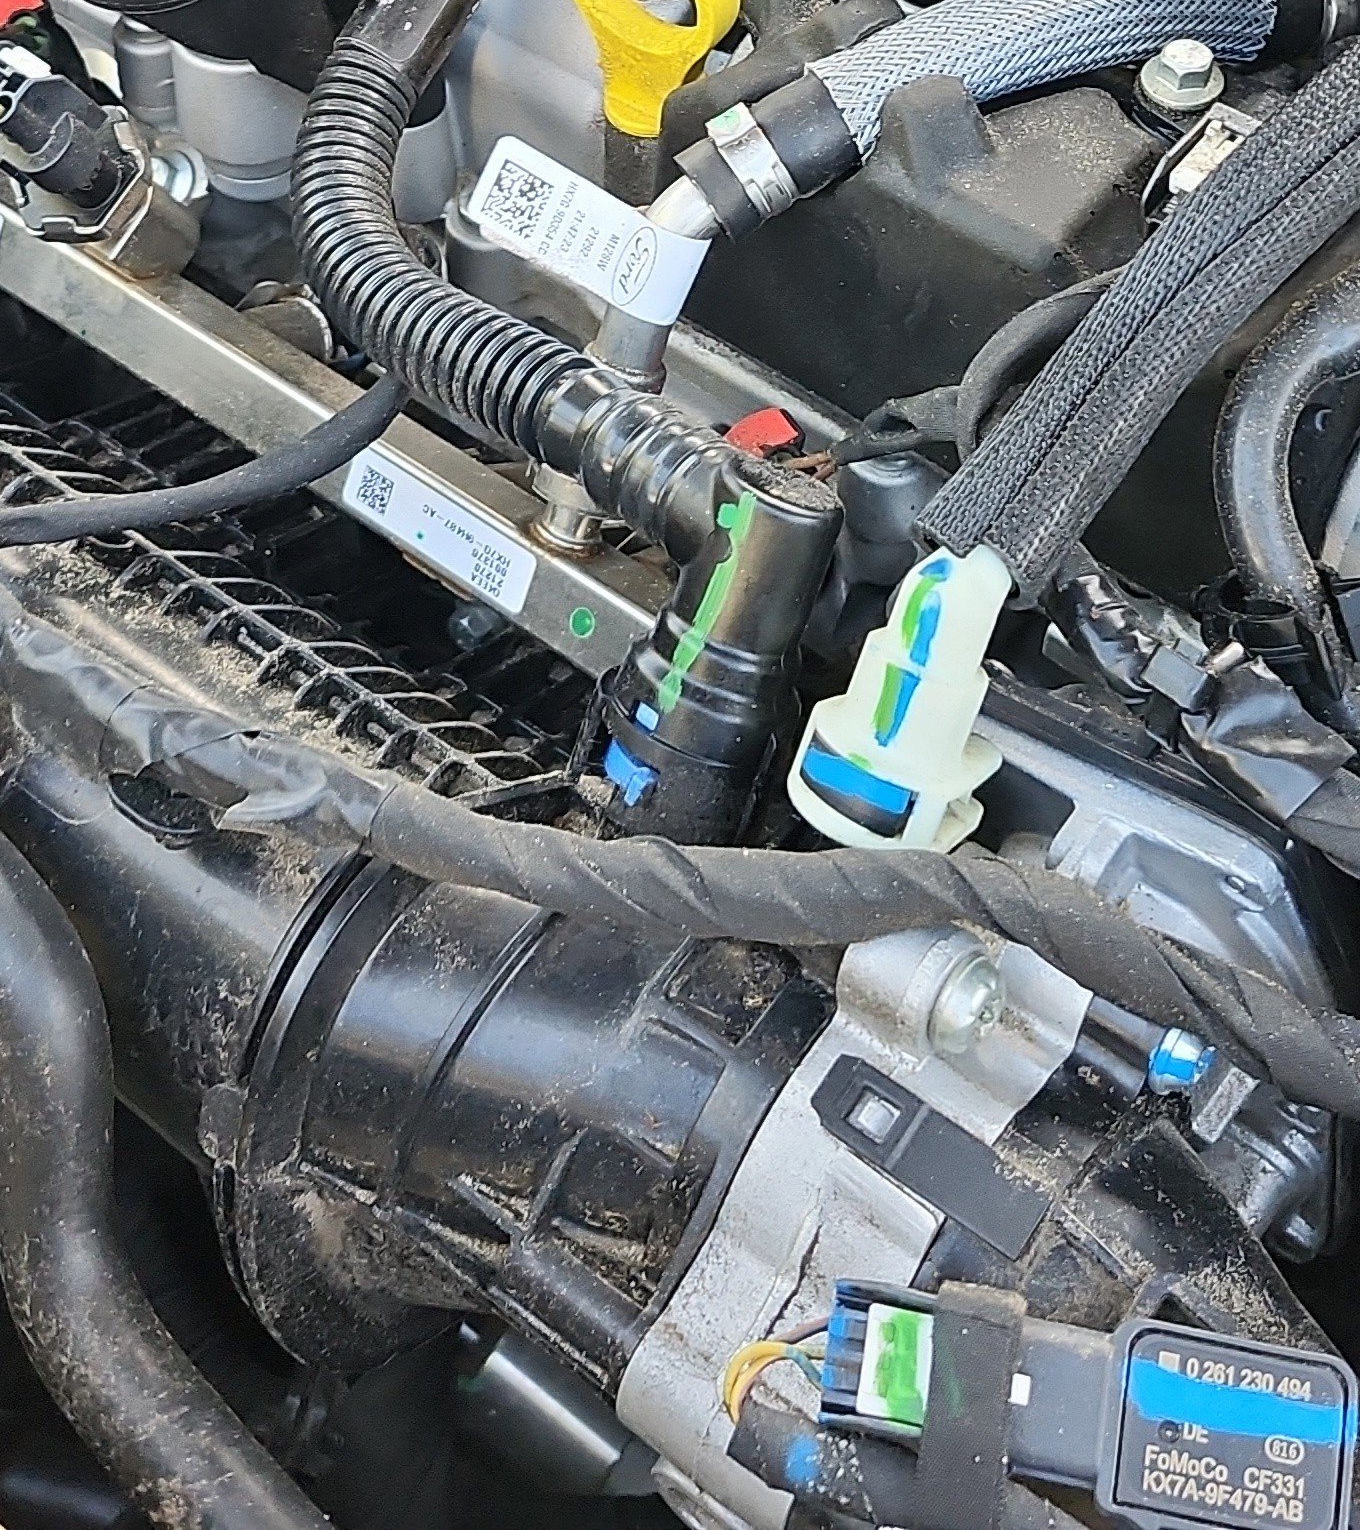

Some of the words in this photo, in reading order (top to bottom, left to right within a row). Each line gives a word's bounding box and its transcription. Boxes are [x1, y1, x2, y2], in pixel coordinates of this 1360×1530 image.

[619, 236, 650, 295] Ford
[1186, 1356, 1198, 1378] 0
[1201, 1360, 1234, 1388] 261
[1239, 1366, 1274, 1394] 230
[1277, 1376, 1312, 1402] 494
[1143, 1444, 1229, 1483] FoMoCo
[1243, 1465, 1306, 1499] CF331
[1271, 1439, 1298, 1460] 816
[1142, 1468, 1304, 1522] KX7A-9F479-AB
